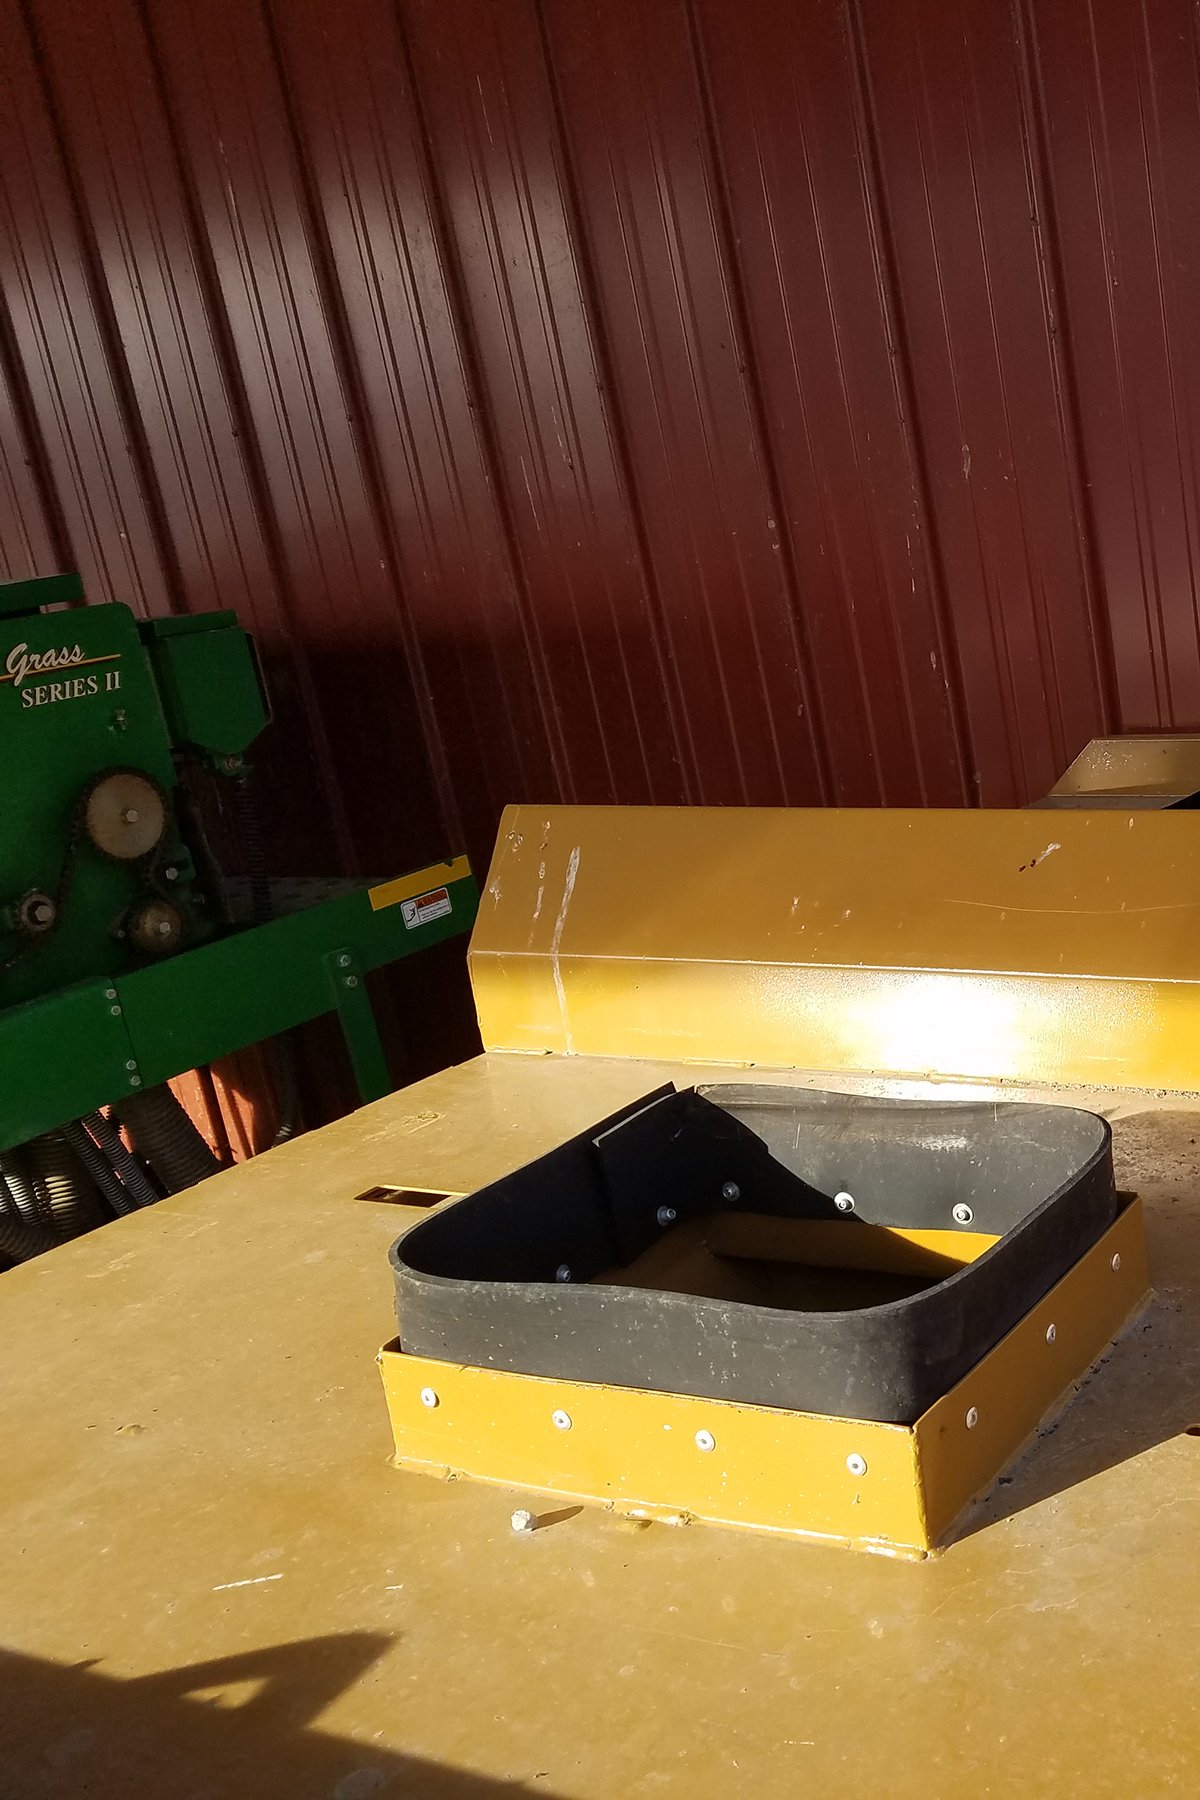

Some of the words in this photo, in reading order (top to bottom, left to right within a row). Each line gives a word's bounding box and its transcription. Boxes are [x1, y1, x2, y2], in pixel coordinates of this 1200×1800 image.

[6, 642, 85, 686] Grass
[21, 675, 98, 708] SERIES
[105, 671, 121, 691] II
